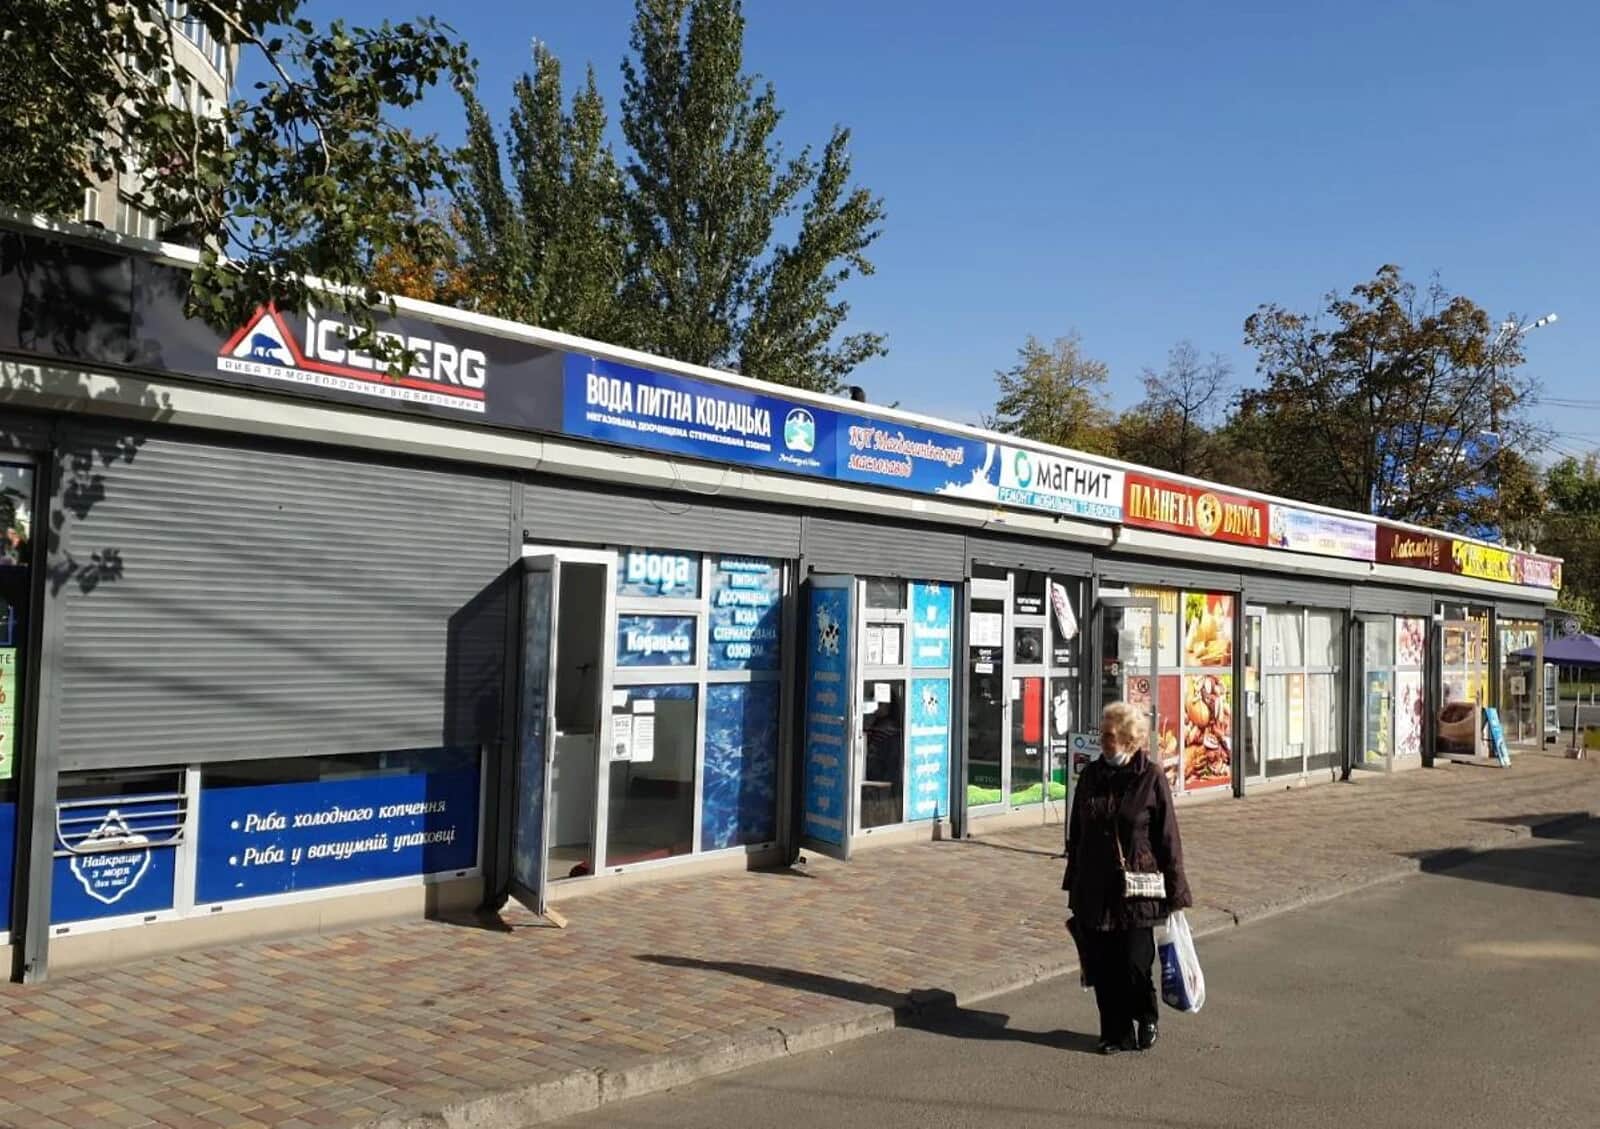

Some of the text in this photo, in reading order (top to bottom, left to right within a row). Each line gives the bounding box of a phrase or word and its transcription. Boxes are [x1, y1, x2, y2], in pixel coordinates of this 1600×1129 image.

[225, 360, 262, 374] РИБА
[267, 366, 282, 378] ТА
[586, 373, 772, 439] ВОДА ПИТНА КОДАЦЬКА
[1129, 483, 1195, 527] ПЛАНЕТА
[1223, 502, 1261, 538] ВКУСА
[243, 800, 446, 833] Риба холодного копчення
[81, 854, 143, 868] Найкраще
[241, 825, 456, 867] Риба у вакуумній упаковці
[102, 867, 130, 879] моря
